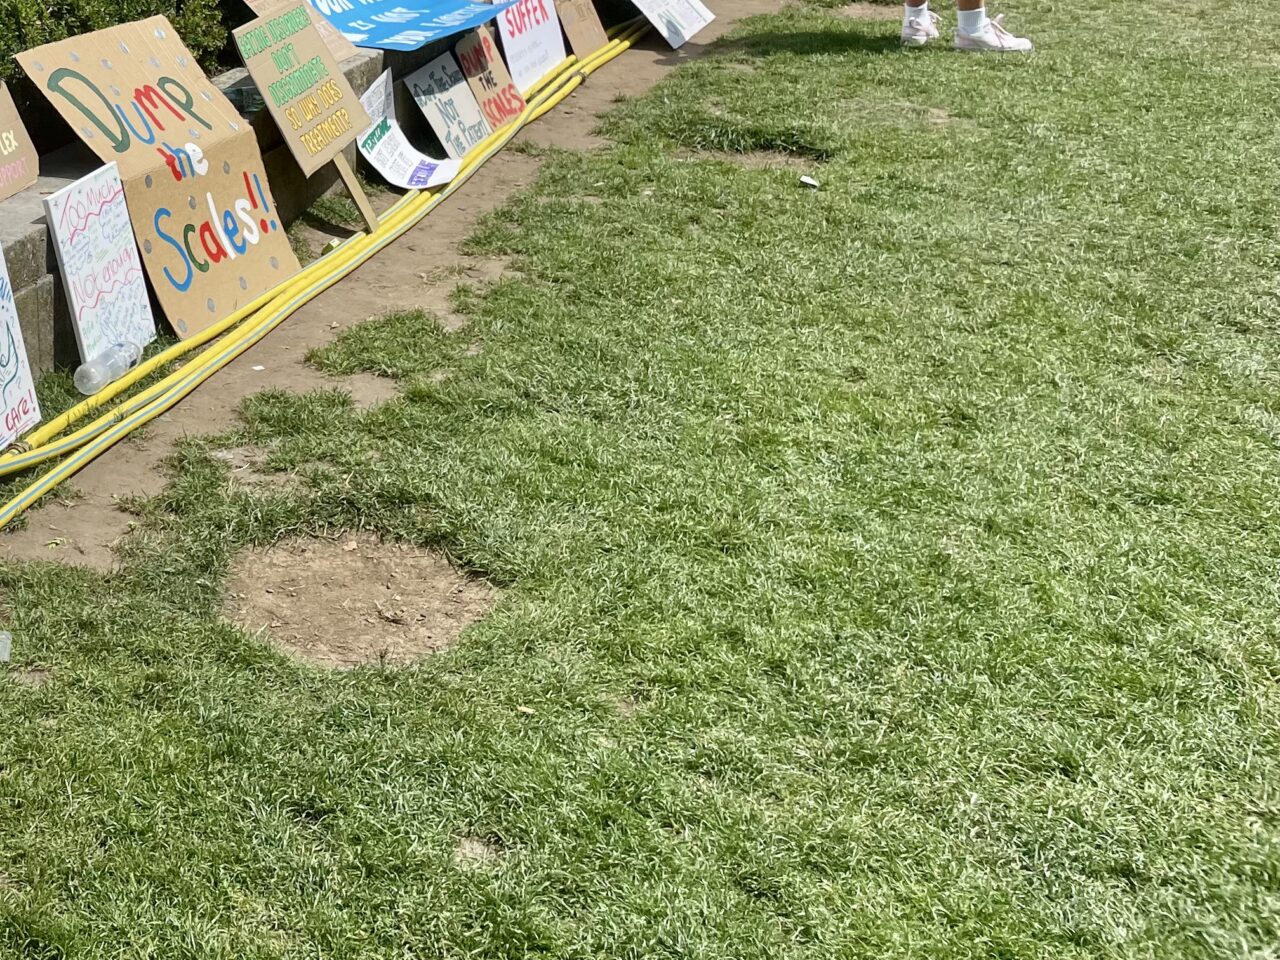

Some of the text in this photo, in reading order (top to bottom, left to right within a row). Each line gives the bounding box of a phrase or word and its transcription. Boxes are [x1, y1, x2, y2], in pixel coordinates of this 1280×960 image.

[238, 26, 272, 59] EATING
[266, 5, 312, 44] DISORDERS
[461, 36, 494, 76] DUMP
[268, 56, 329, 108] DISCRIMINATE
[285, 79, 343, 131] SO WHY DOES
[478, 70, 497, 91] THE
[47, 67, 212, 154] Dump
[483, 83, 526, 128] SCALES
[300, 107, 352, 156] TREATMENT?
[156, 142, 209, 182] the
[60, 181, 117, 231] Too Much
[73, 267, 103, 305] Not
